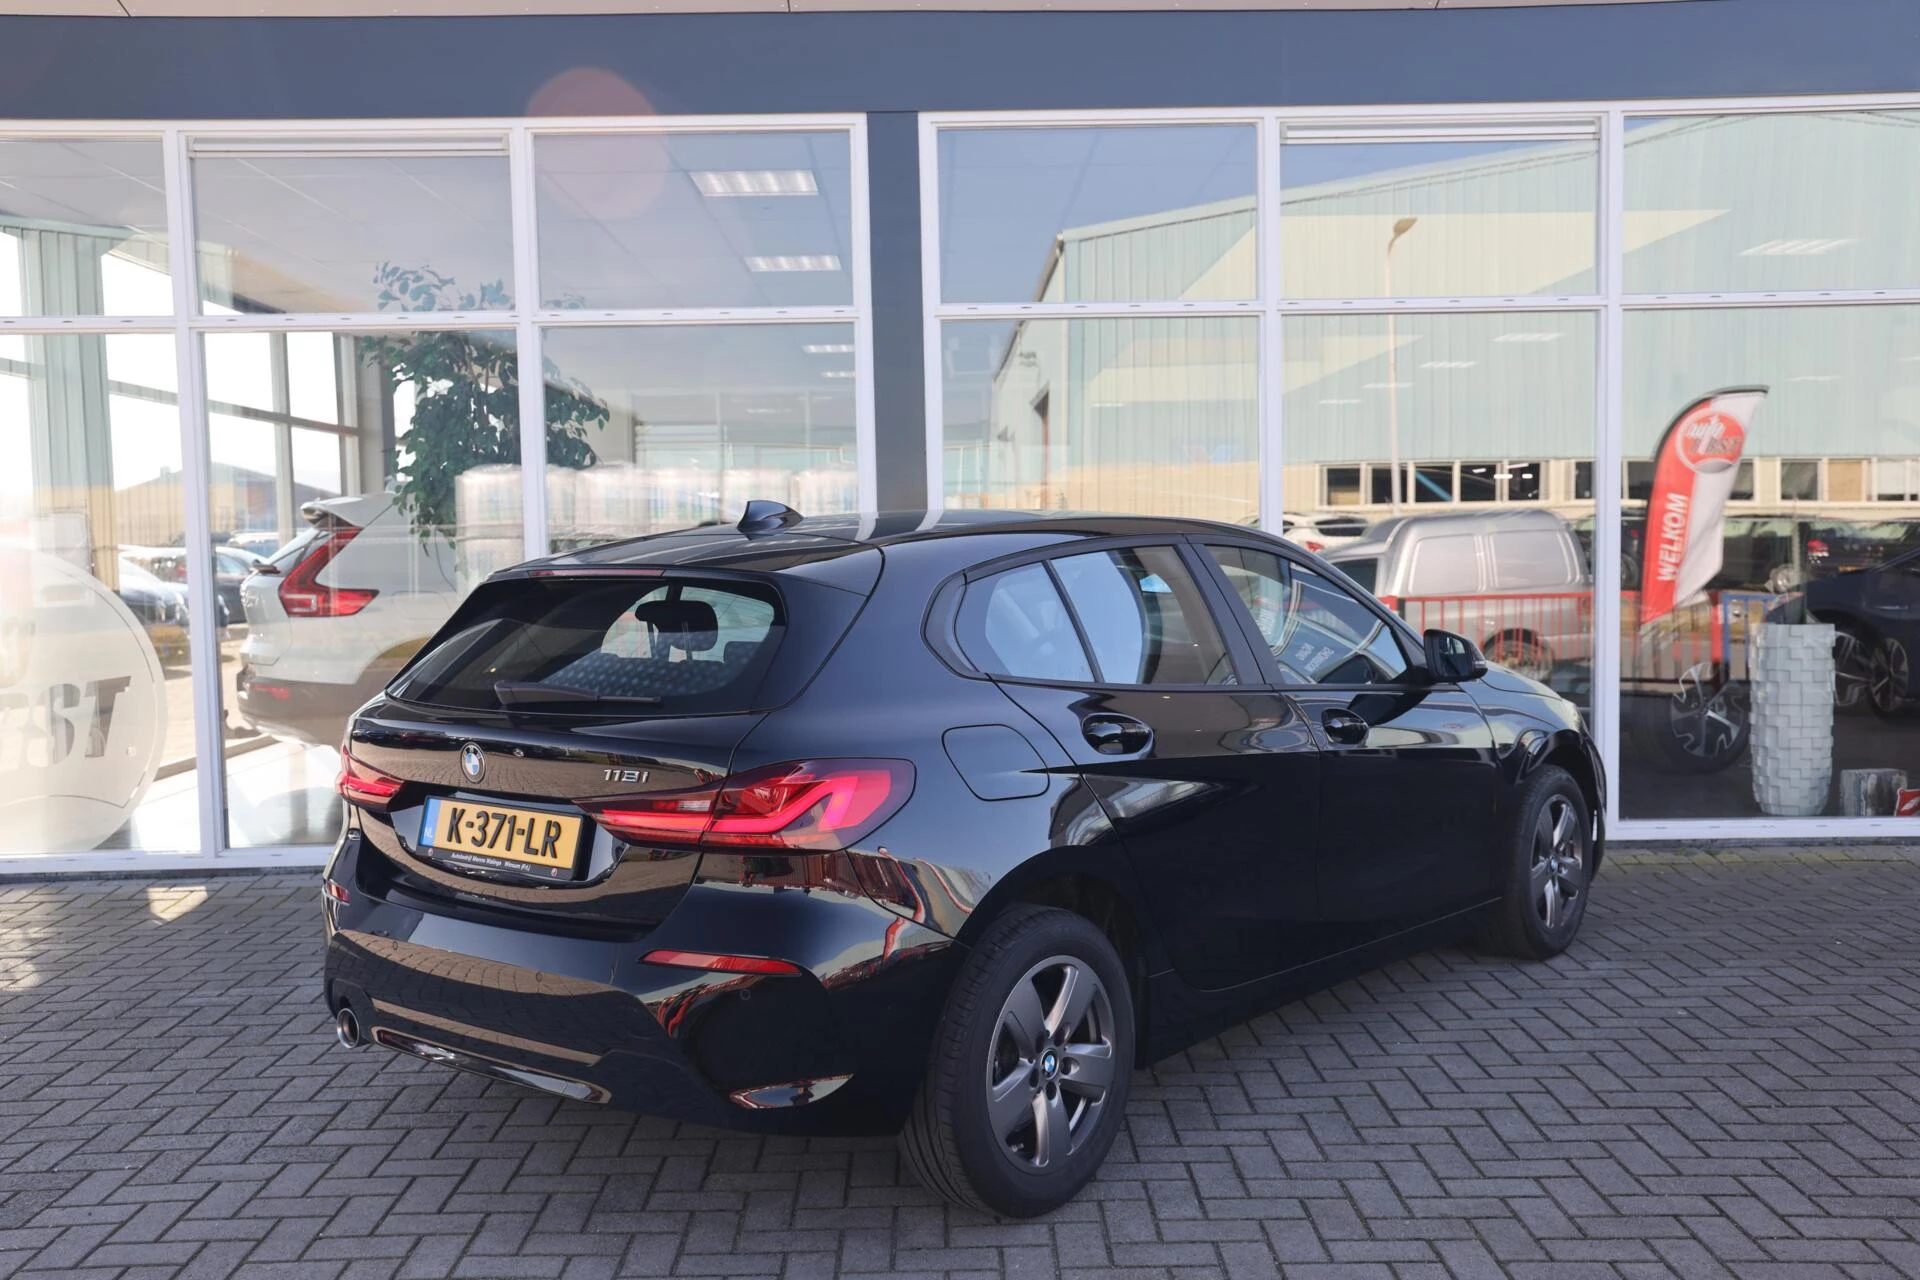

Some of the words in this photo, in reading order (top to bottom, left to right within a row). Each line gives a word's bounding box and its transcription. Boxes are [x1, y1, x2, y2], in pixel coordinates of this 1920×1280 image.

[1656, 492, 1689, 581] WELKOM
[603, 769, 649, 783] 118i
[447, 807, 562, 859] K-371-LR
